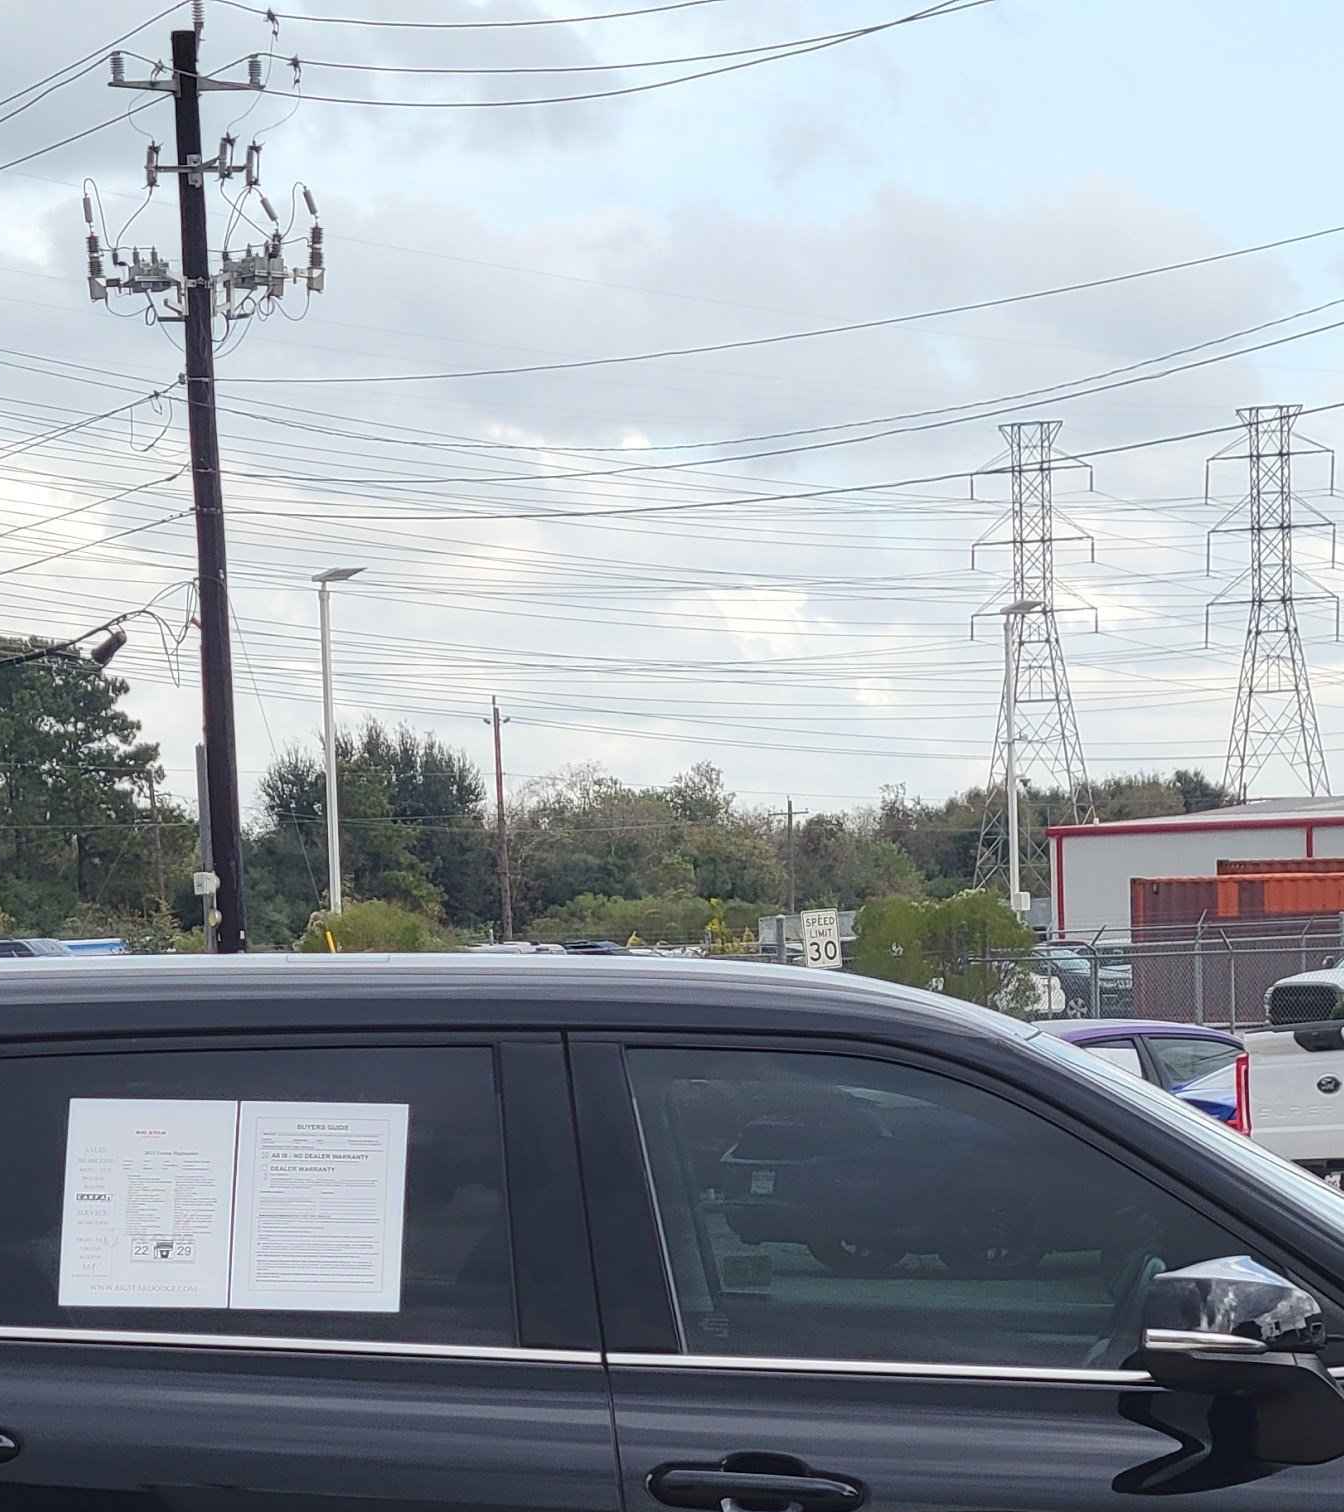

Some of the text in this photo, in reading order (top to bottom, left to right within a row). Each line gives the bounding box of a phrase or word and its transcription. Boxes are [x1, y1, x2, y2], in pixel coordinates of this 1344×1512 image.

[806, 916, 835, 927] SPEED
[810, 929, 832, 938] LIMIT
[810, 940, 837, 961] 30
[1258, 1104, 1337, 1120] SUPER
[134, 1245, 192, 1256] 22 29
